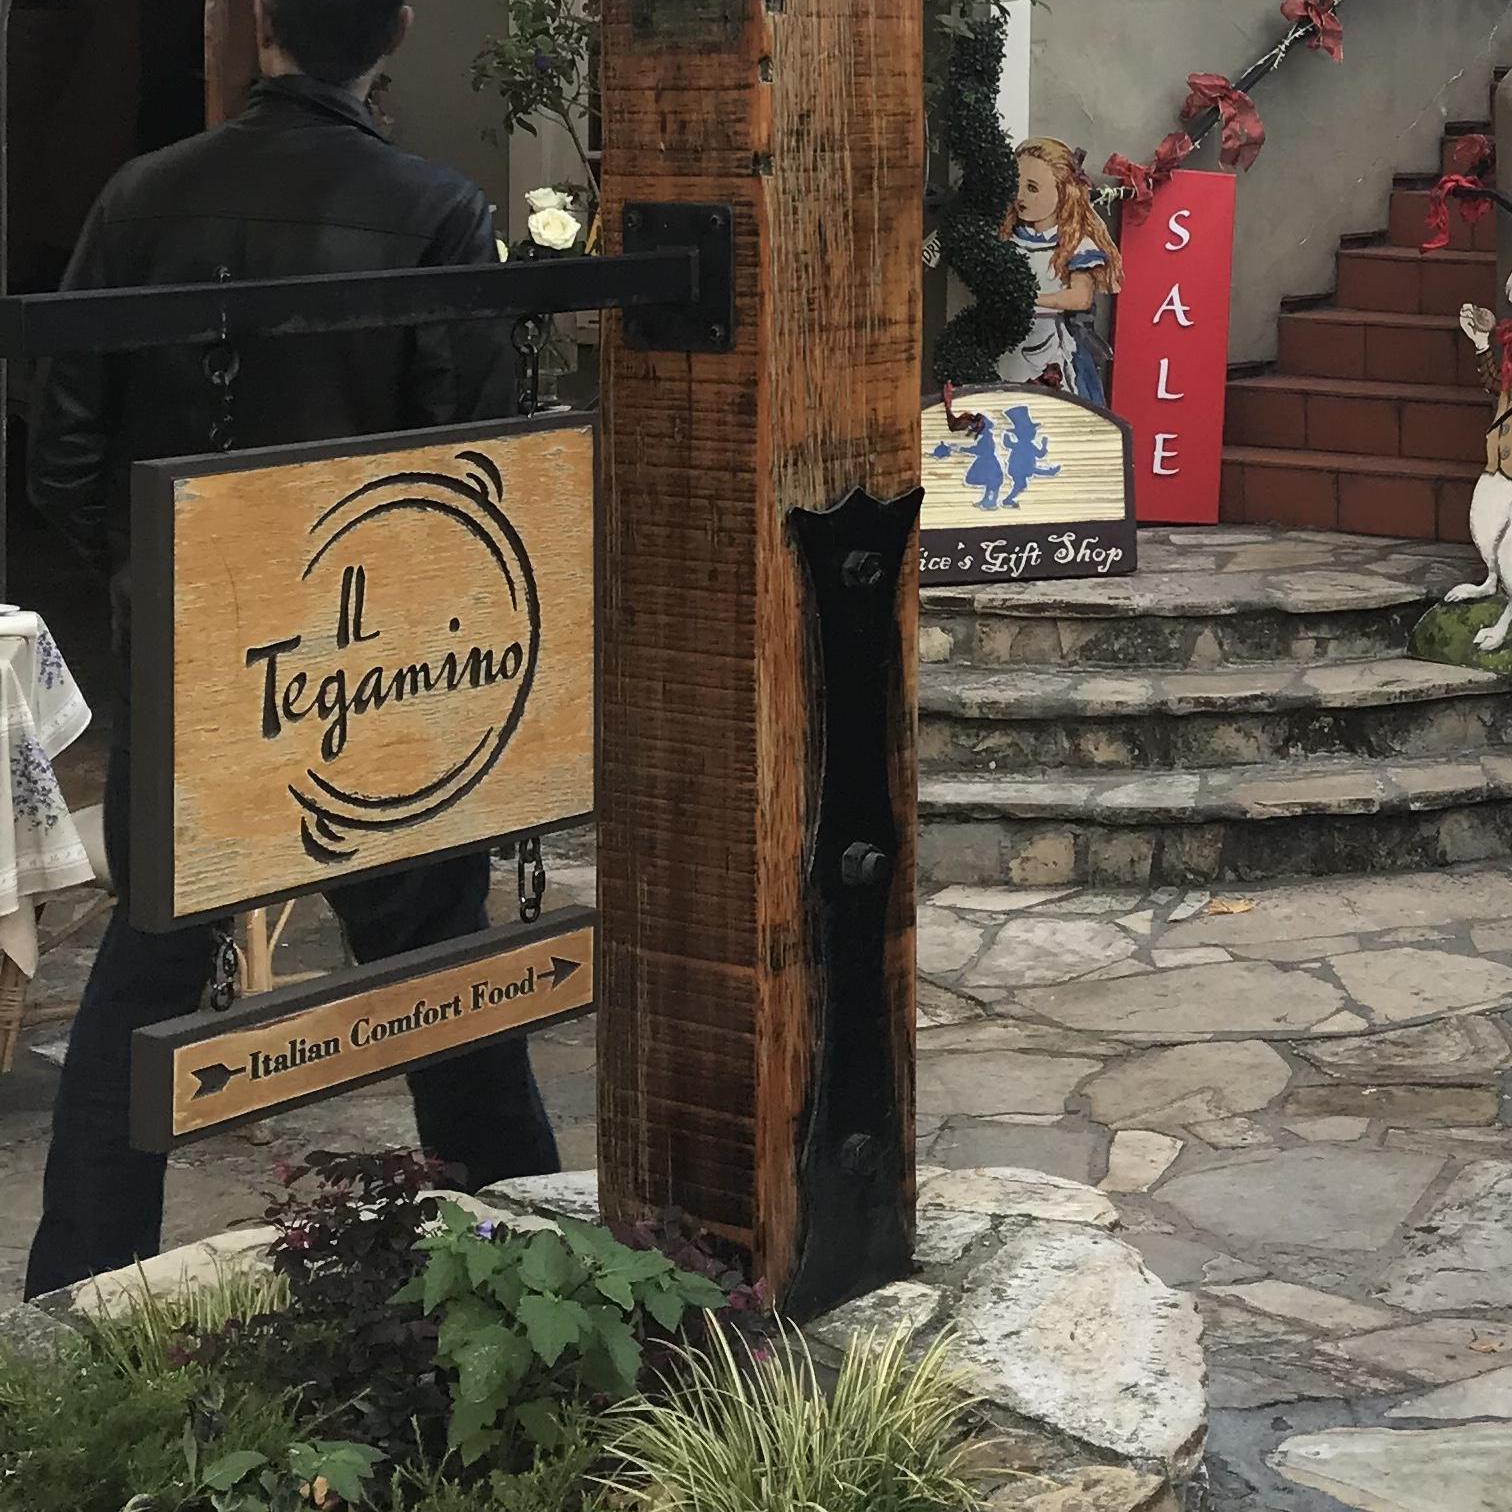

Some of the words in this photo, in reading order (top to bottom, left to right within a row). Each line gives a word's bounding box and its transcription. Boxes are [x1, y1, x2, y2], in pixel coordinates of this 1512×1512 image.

[919, 541, 974, 572] ice's
[980, 539, 1042, 578] Gift
[1047, 531, 1123, 573] Shop
[245, 617, 524, 761] Tegamino
[248, 1033, 341, 1080] Italian
[349, 996, 463, 1050] Comfort
[471, 966, 535, 1014] Food
